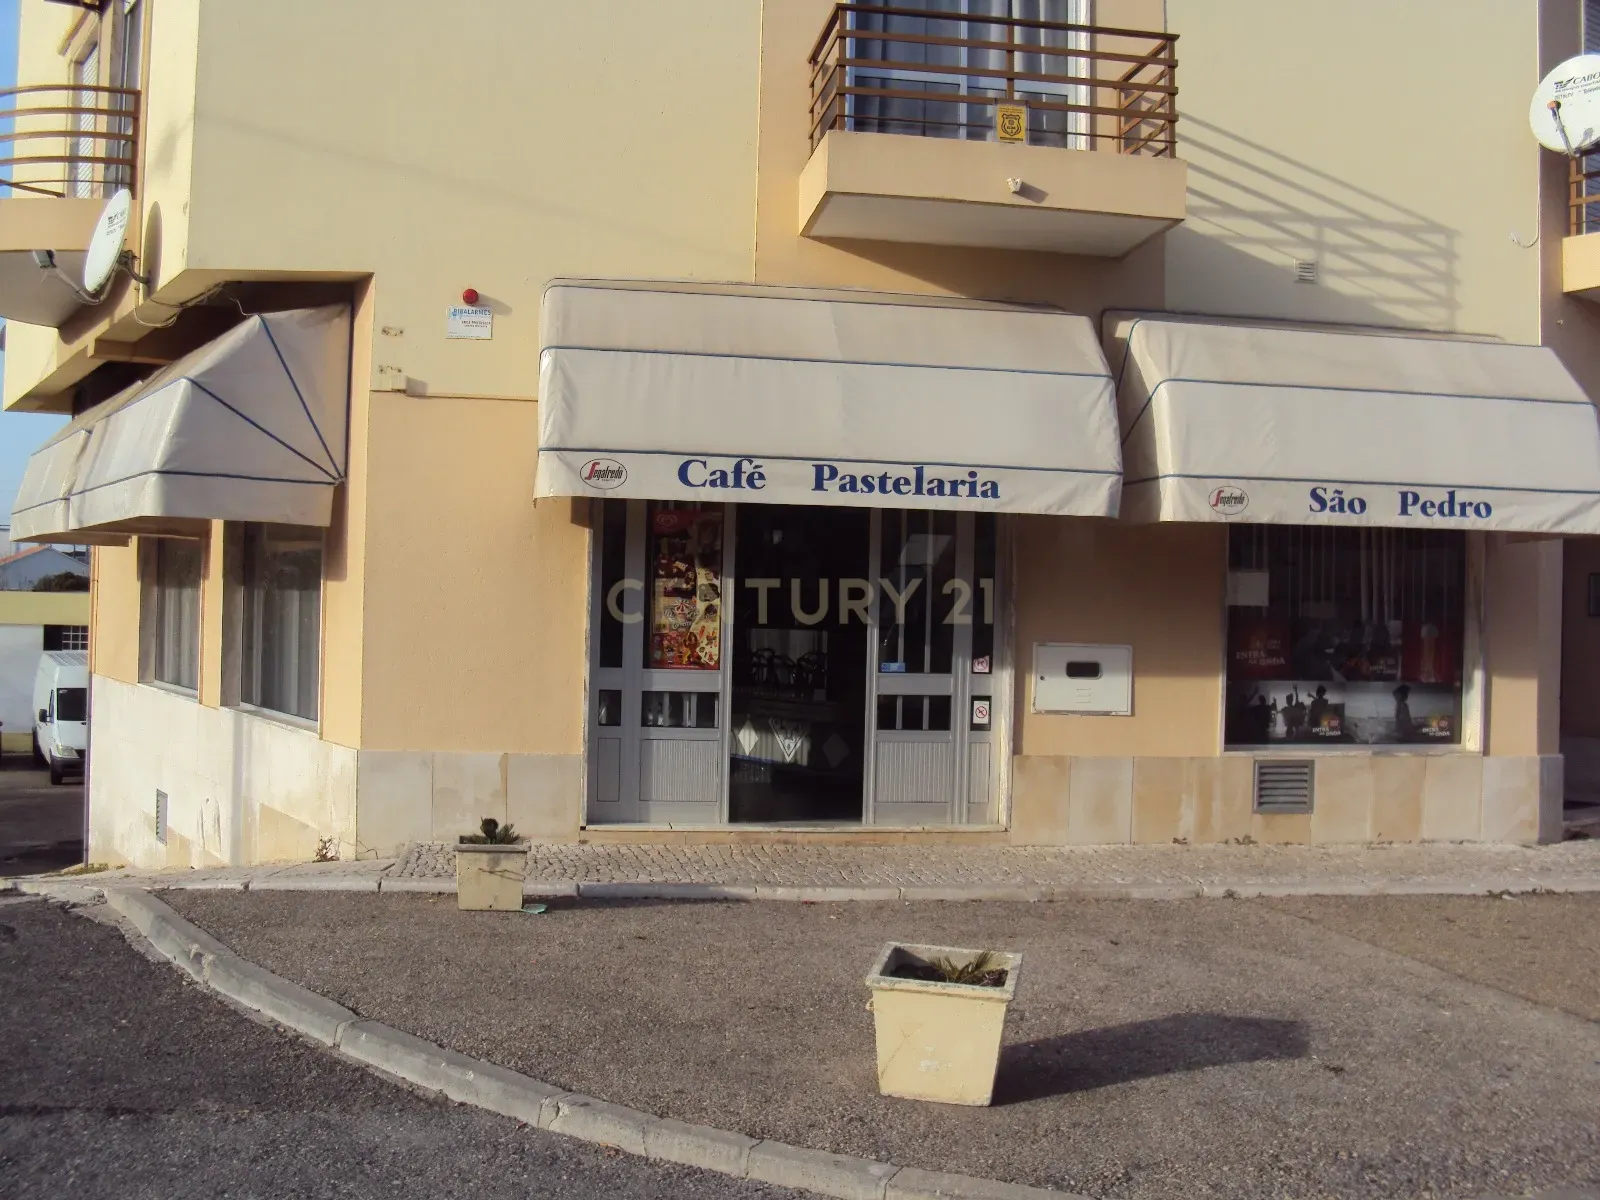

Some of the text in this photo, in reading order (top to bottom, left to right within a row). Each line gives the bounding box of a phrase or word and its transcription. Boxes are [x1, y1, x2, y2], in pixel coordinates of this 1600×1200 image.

[584, 461, 624, 481] Segafredo
[677, 458, 1001, 499] Café Pastelaria
[1309, 486, 1492, 519] São Pedro
